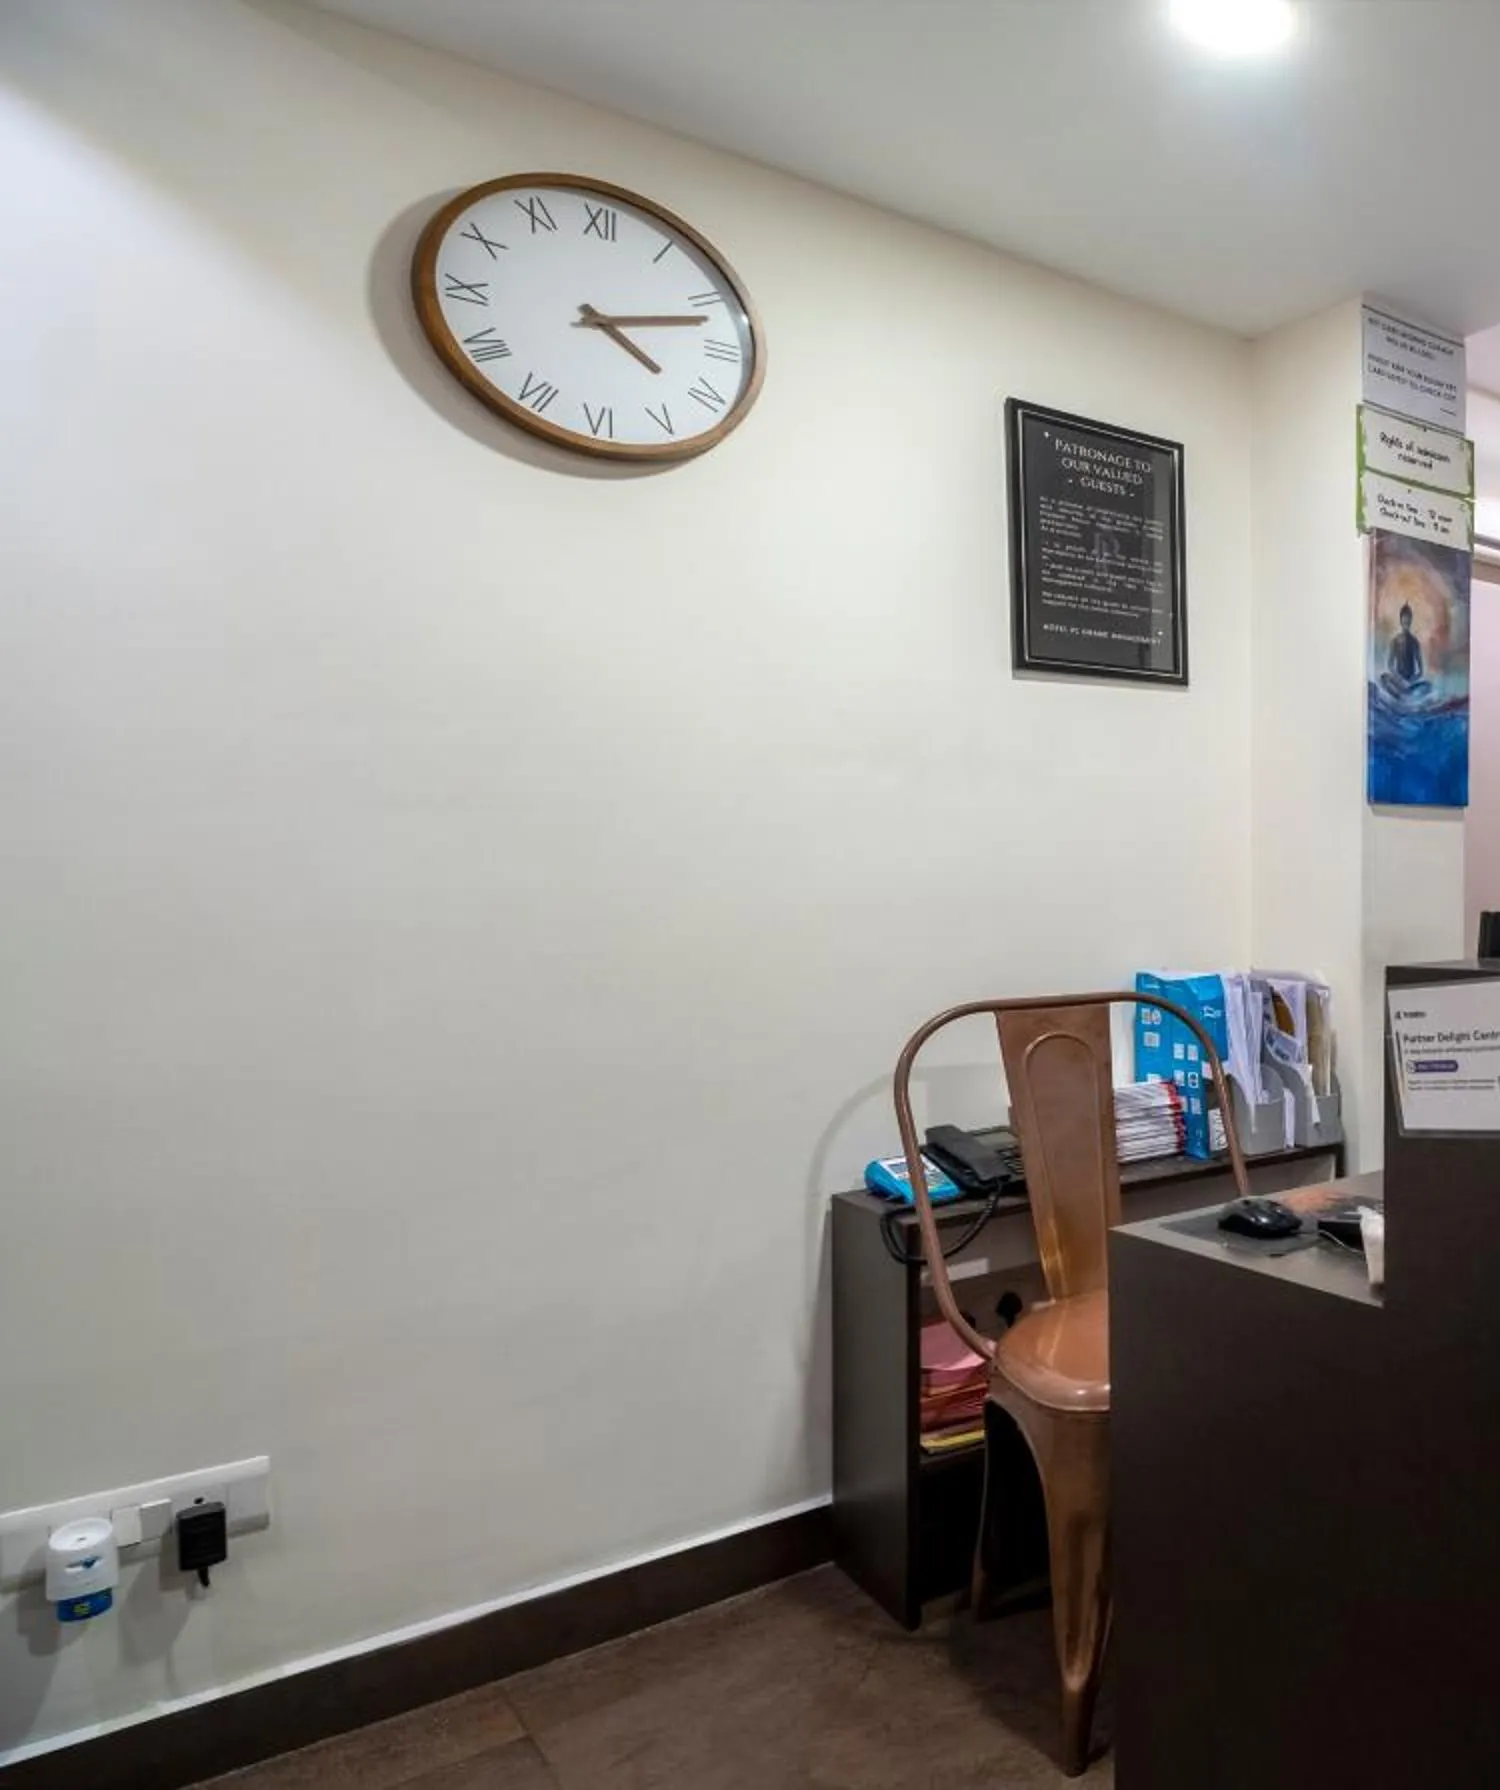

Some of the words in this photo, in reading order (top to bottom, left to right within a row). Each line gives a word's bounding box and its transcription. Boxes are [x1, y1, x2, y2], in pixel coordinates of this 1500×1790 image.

[511, 195, 558, 235] XI
[583, 202, 617, 242] XII
[459, 222, 509, 261] X
[444, 272, 490, 307] IX
[687, 291, 722, 307] II
[462, 327, 513, 363] VIII
[703, 339, 740, 363] III
[518, 371, 560, 413] VII
[687, 376, 726, 414] IV
[583, 402, 614, 440] VI
[643, 402, 675, 436] V
[1055, 438, 1132, 469] PATRONAGE
[1134, 459, 1151, 473] TO
[1061, 456, 1091, 474] OUR
[1092, 462, 1143, 486] VALUED
[1079, 475, 1127, 496] GUESTS
[1403, 1032, 1436, 1044] Partner
[1437, 1030, 1471, 1044] Delight
